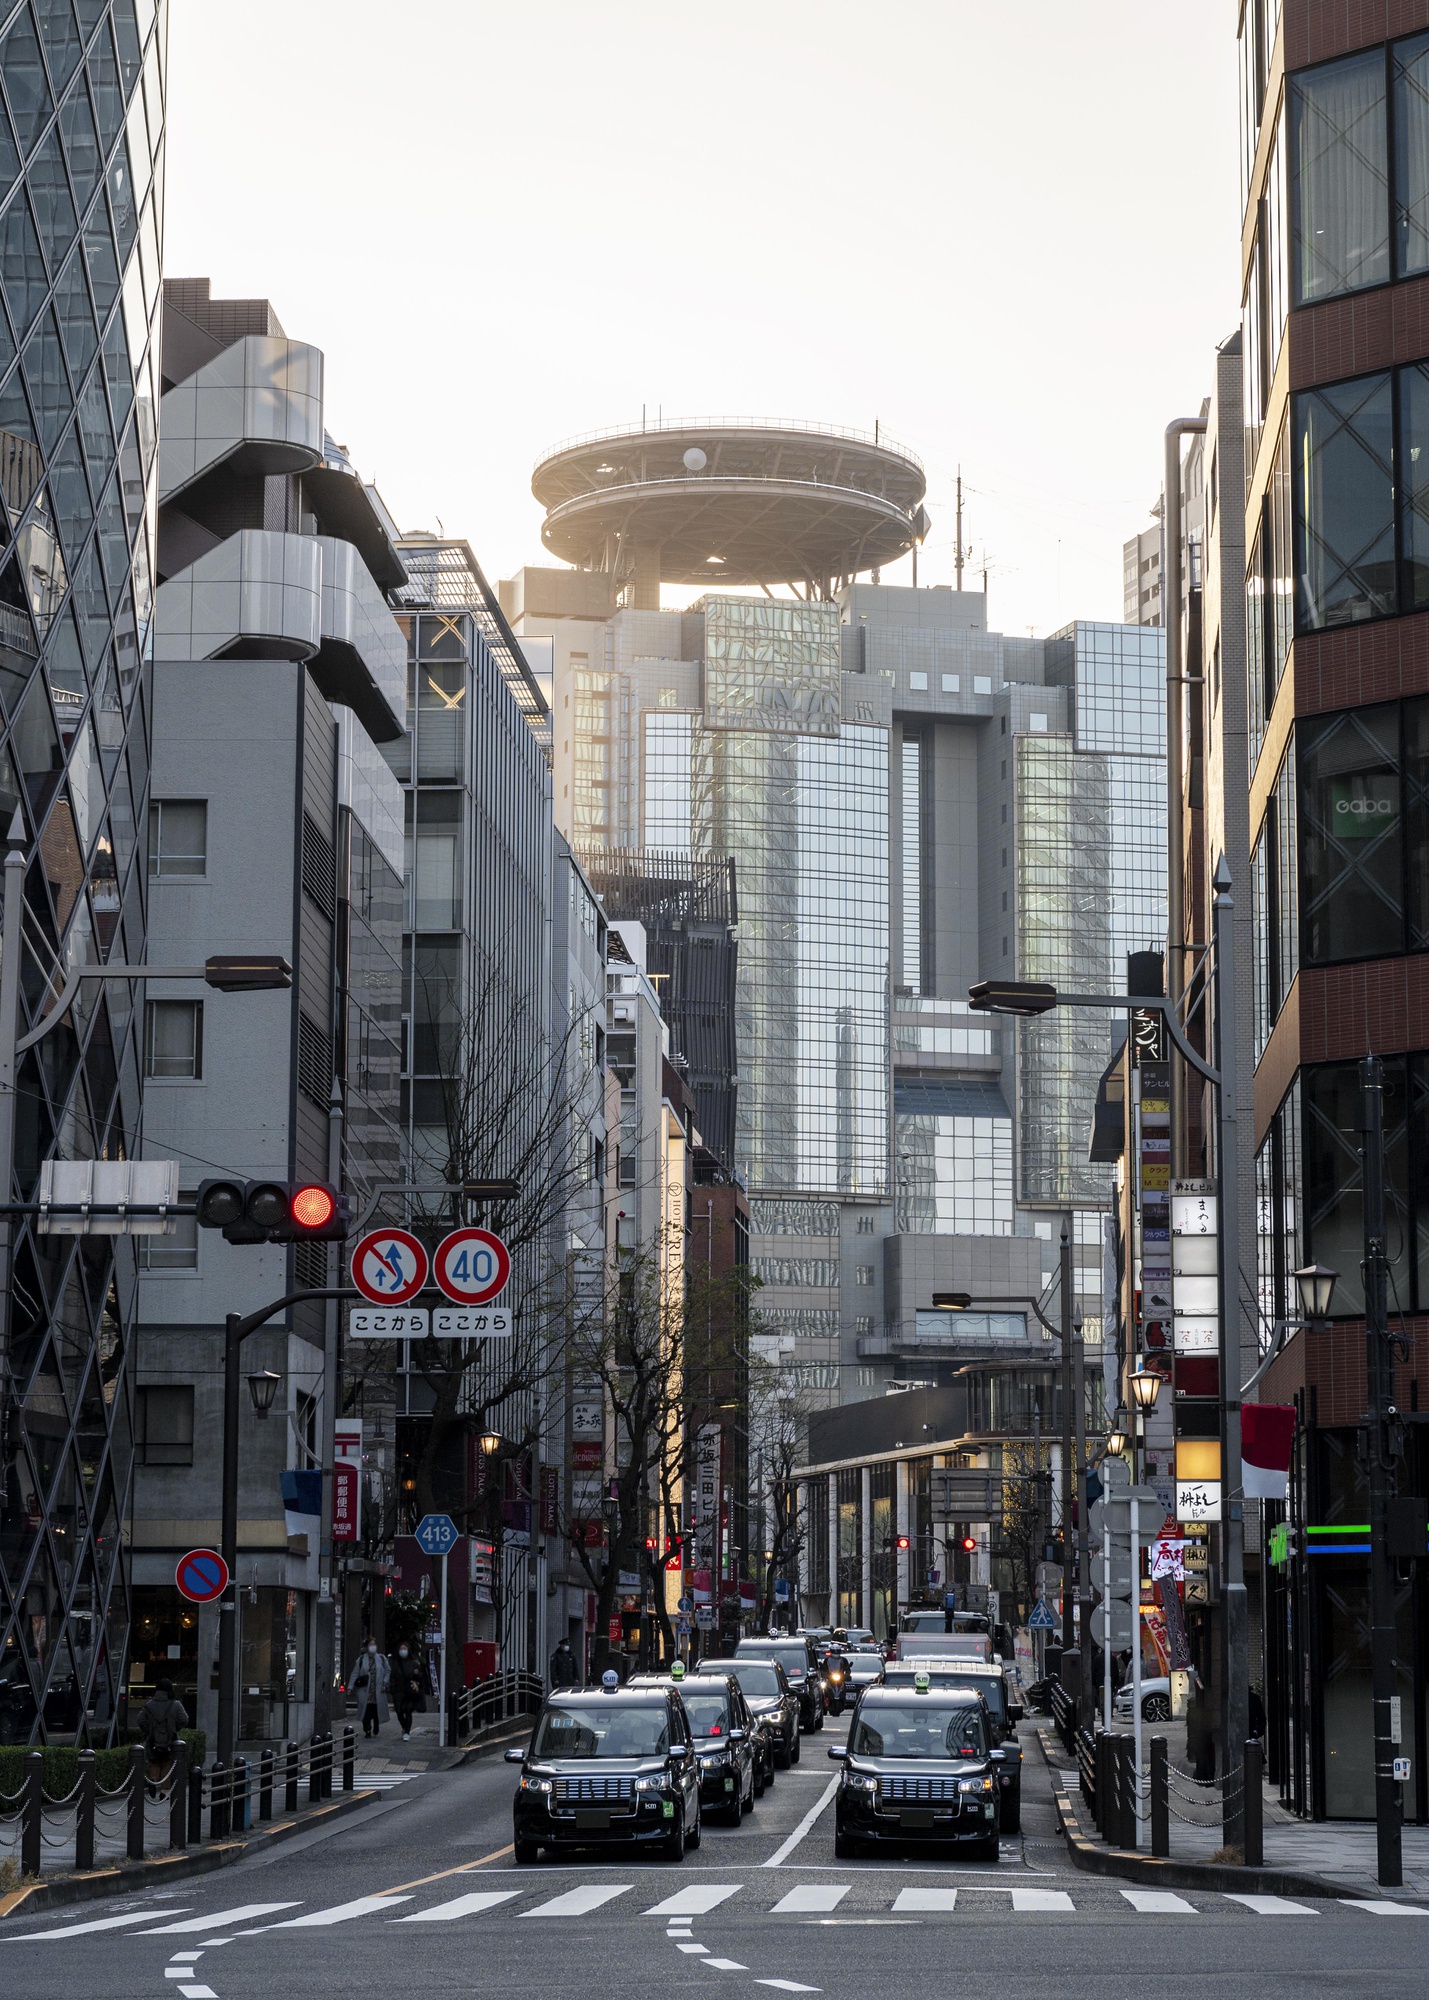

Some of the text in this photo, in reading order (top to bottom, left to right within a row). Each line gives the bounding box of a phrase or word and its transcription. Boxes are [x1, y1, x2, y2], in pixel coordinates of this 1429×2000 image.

[452, 1250, 492, 1283] 40
[355, 1316, 424, 1331] ここから
[438, 1315, 507, 1331] ここから
[422, 1526, 451, 1542] 413
